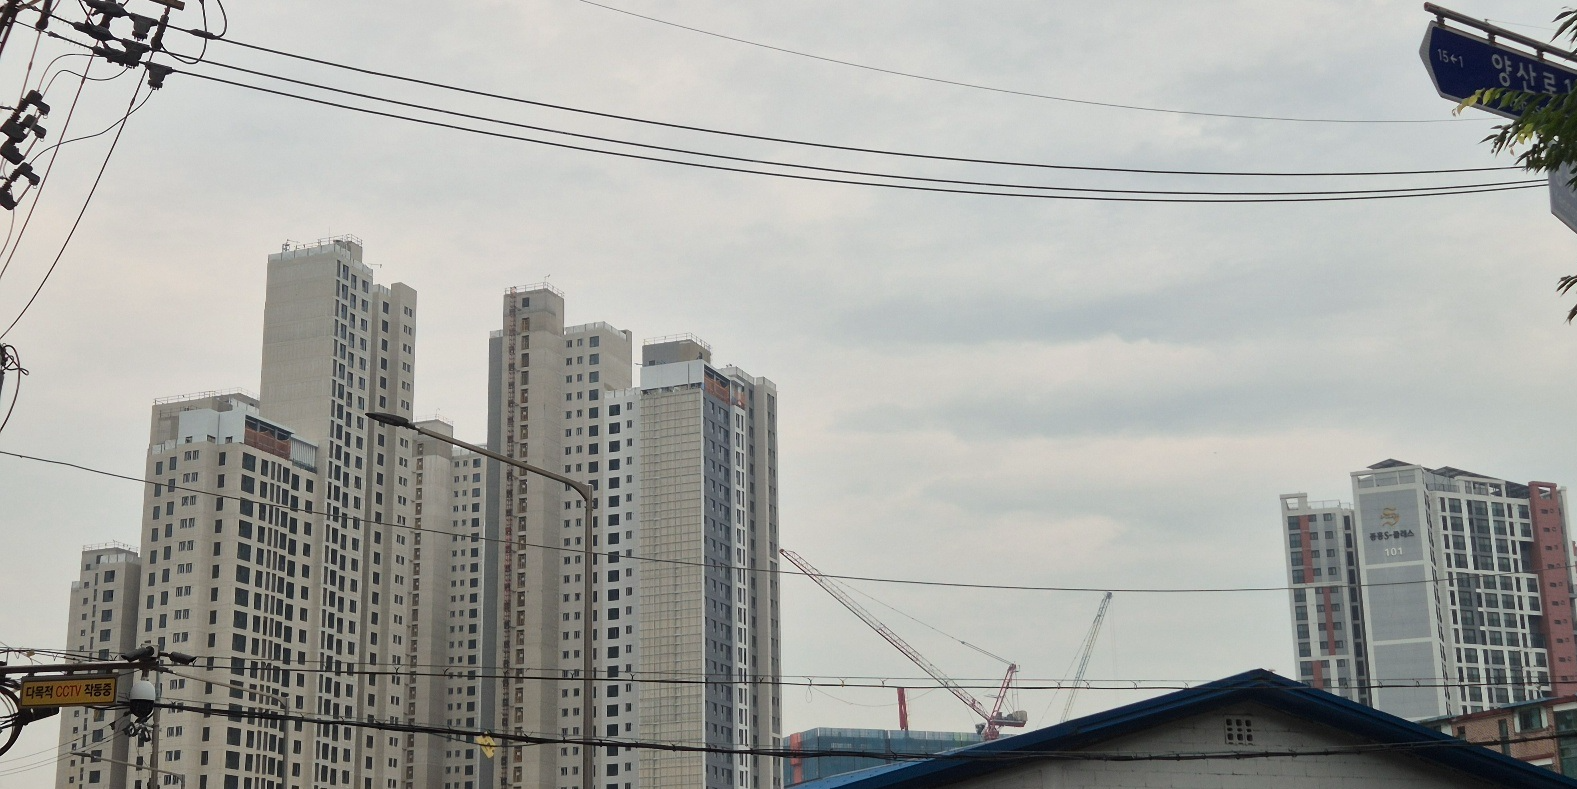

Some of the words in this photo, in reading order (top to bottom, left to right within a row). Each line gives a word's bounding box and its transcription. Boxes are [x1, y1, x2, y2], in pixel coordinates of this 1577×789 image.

[1384, 546, 1404, 557] 101
[25, 685, 54, 699] 다목적
[55, 686, 83, 698] CCTV
[83, 683, 113, 698] 작동중
